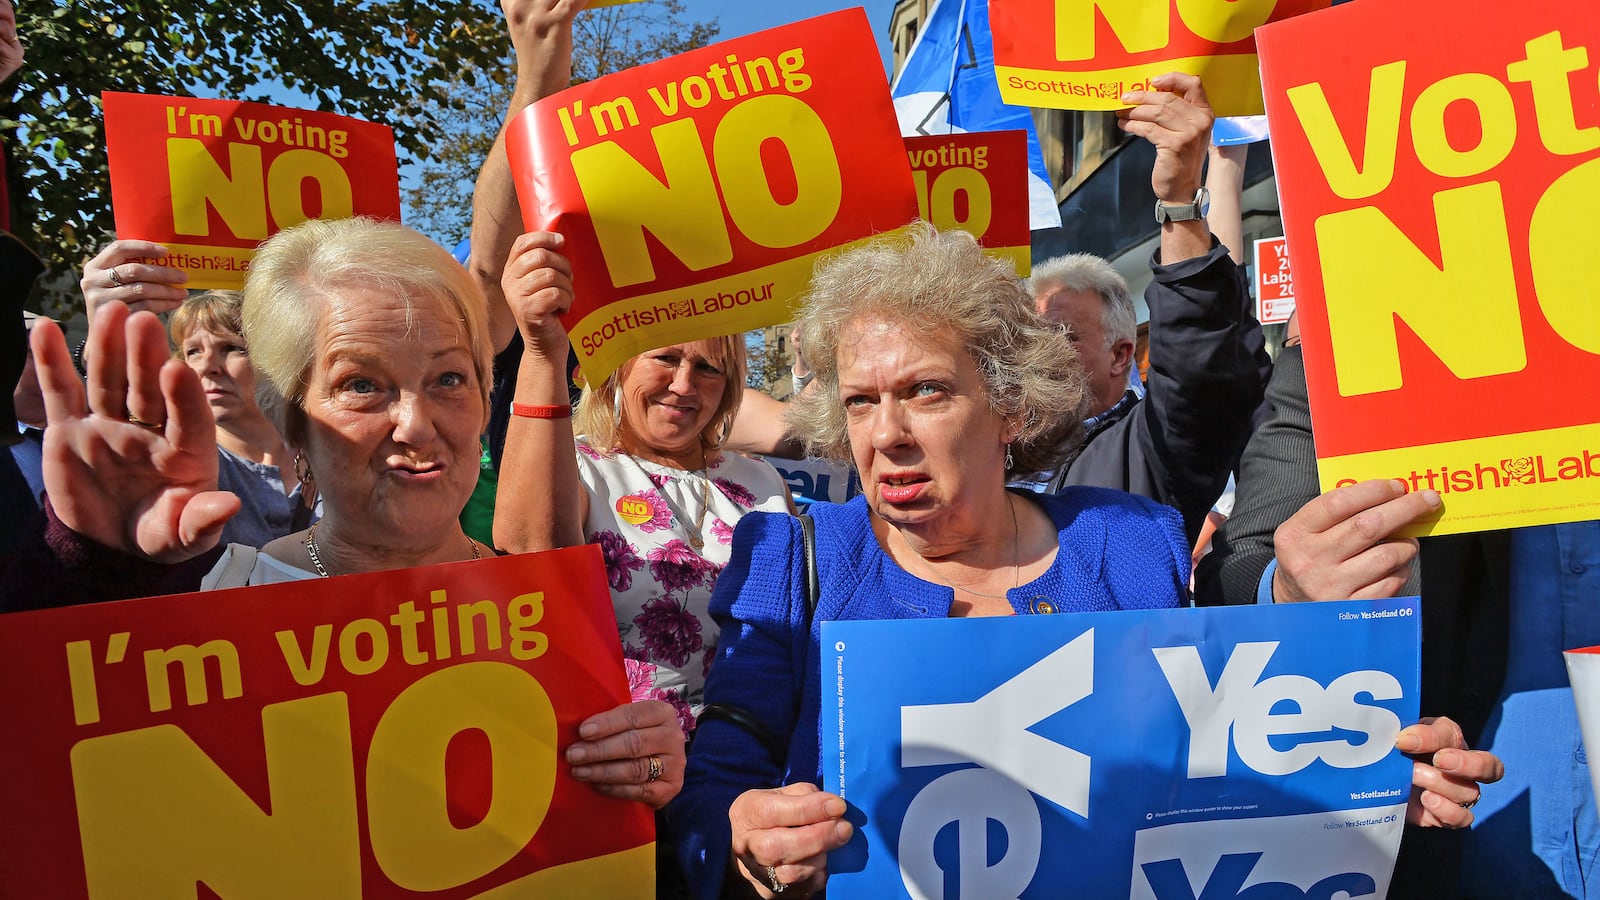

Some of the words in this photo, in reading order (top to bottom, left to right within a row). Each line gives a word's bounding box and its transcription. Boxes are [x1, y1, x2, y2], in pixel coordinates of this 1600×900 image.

[557, 99, 640, 147] I'm
[647, 47, 812, 117] voting
[1008, 76, 1101, 98] Scottish
[1286, 30, 1600, 200] Vot
[166, 106, 222, 137] I'm
[234, 118, 348, 158] voting
[908, 142, 988, 170] voting
[166, 138, 353, 240] NO
[569, 94, 842, 288] NO
[581, 306, 672, 357] Scottish
[690, 283, 774, 316] Labour
[622, 501, 648, 515] NO
[65, 632, 243, 726] I'm
[276, 590, 549, 686] voting
[1339, 611, 1360, 620] Follow
[1152, 641, 1403, 779] Yes
[70, 661, 558, 900] NO
[1323, 822, 1343, 831] Follow
